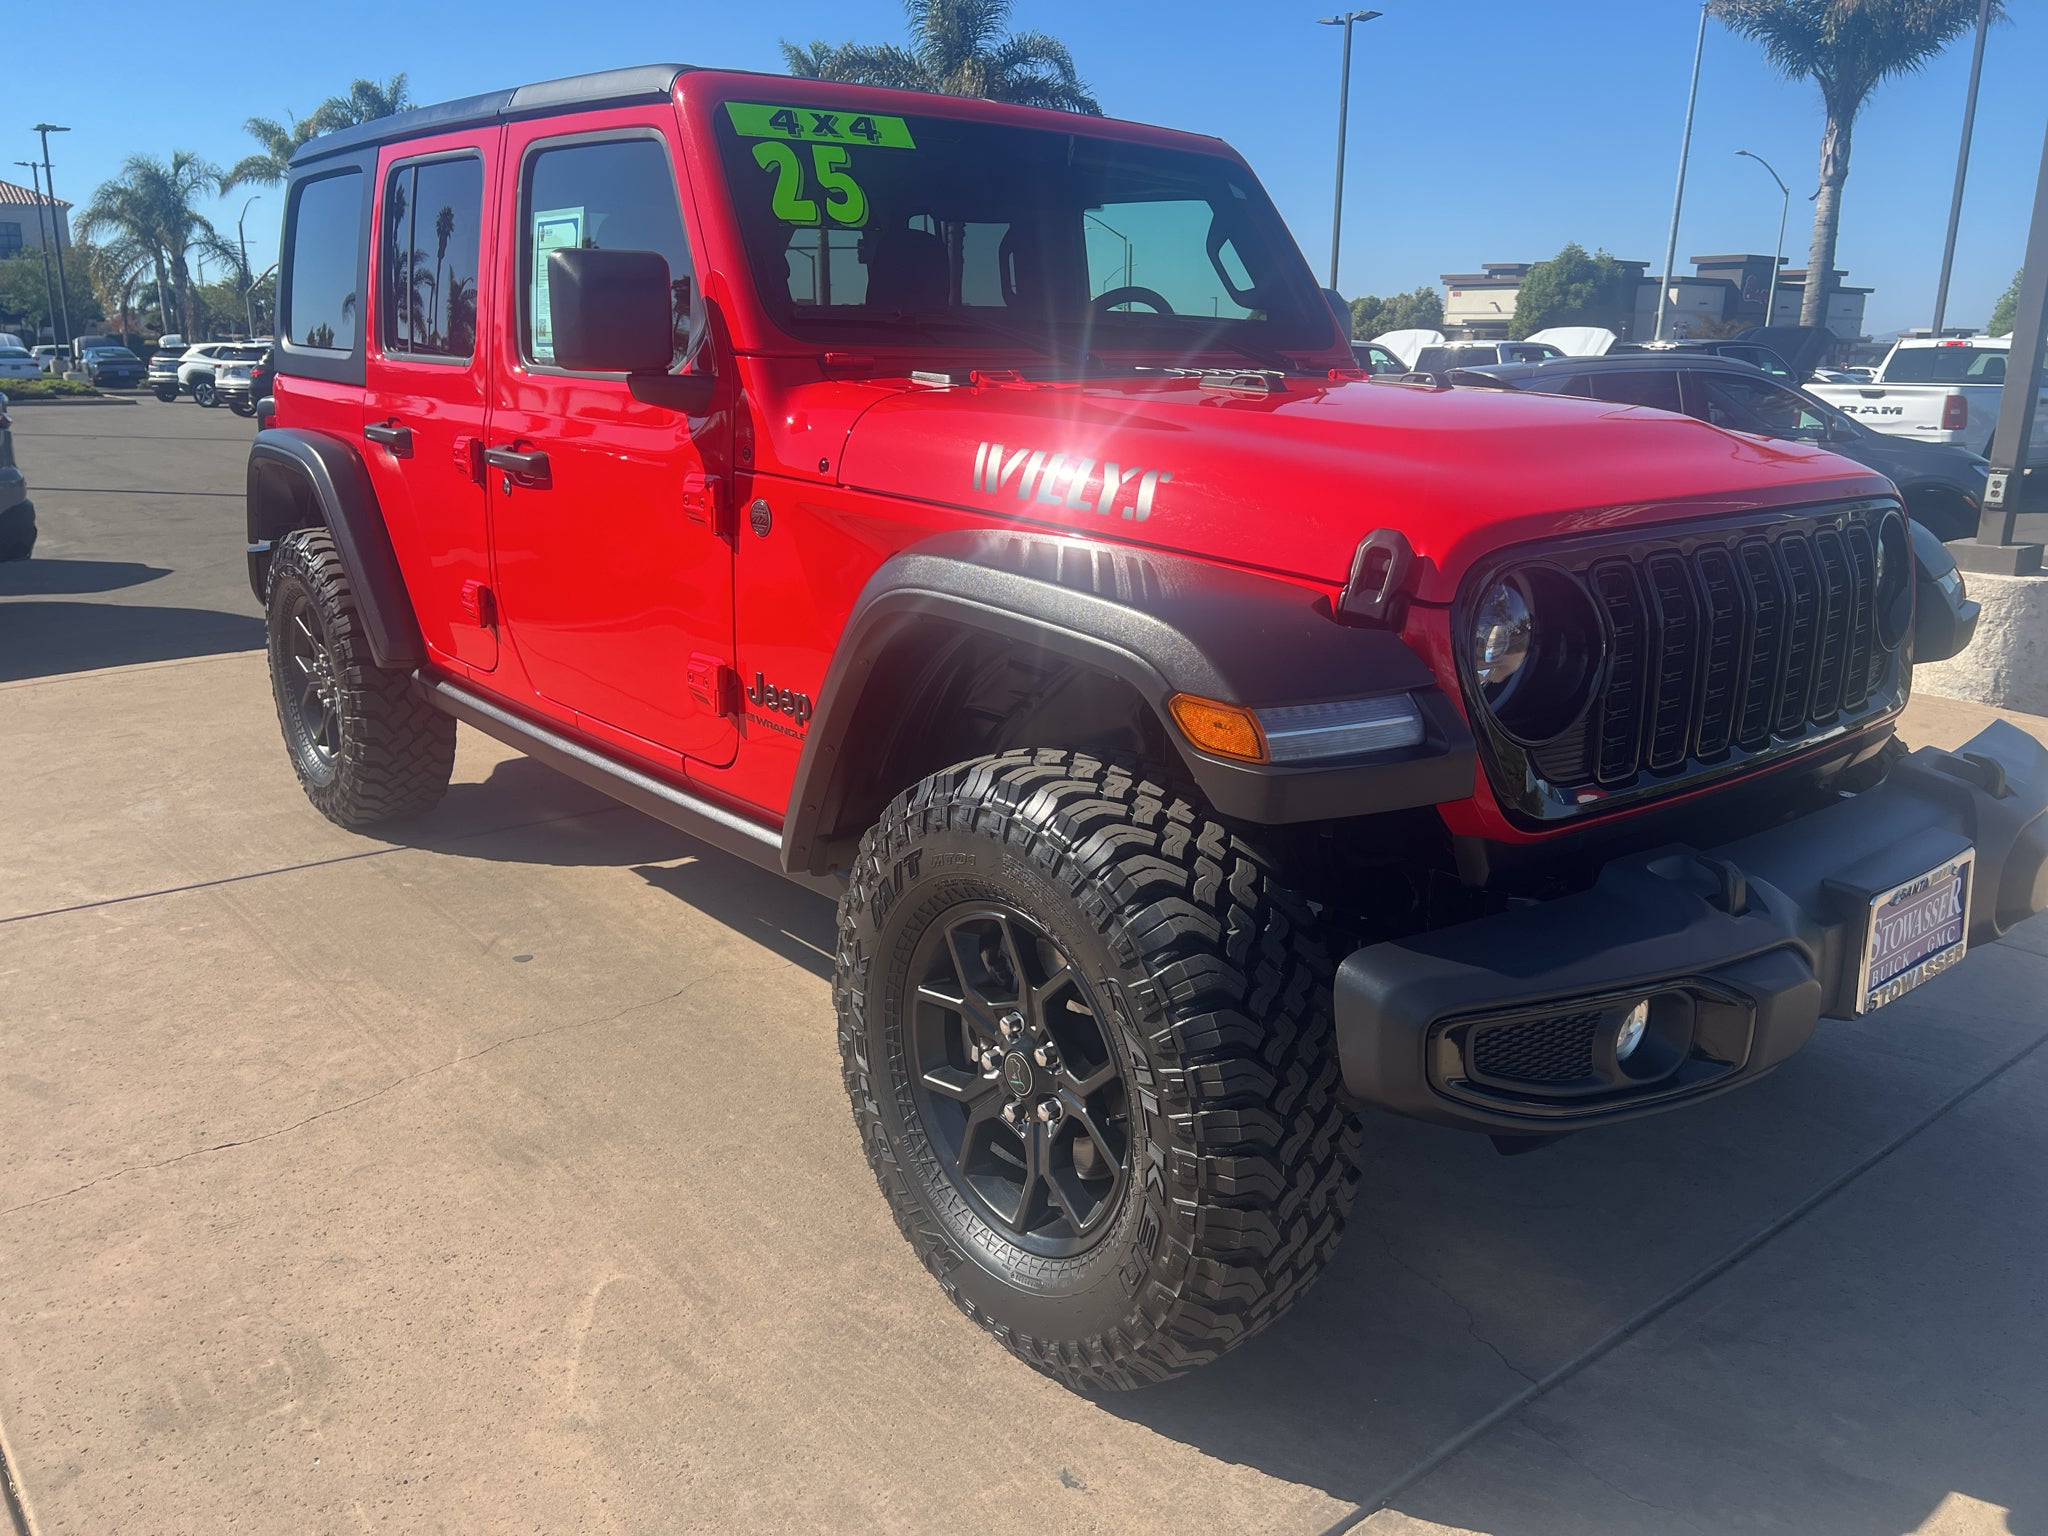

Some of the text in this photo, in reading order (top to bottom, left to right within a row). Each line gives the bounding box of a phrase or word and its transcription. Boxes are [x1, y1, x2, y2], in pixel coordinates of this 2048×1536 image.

[752, 141, 869, 227] 25
[1839, 406, 1903, 415] RAM
[973, 441, 1173, 522] WILLYS
[747, 672, 812, 727] Jeep
[756, 715, 806, 740] WRANGLE
[1899, 877, 1930, 900] SANTA
[1871, 877, 1962, 962] STOWASSER
[1867, 944, 1965, 1012] STOWASSER
[1872, 926, 1956, 987] BUICK GMC
